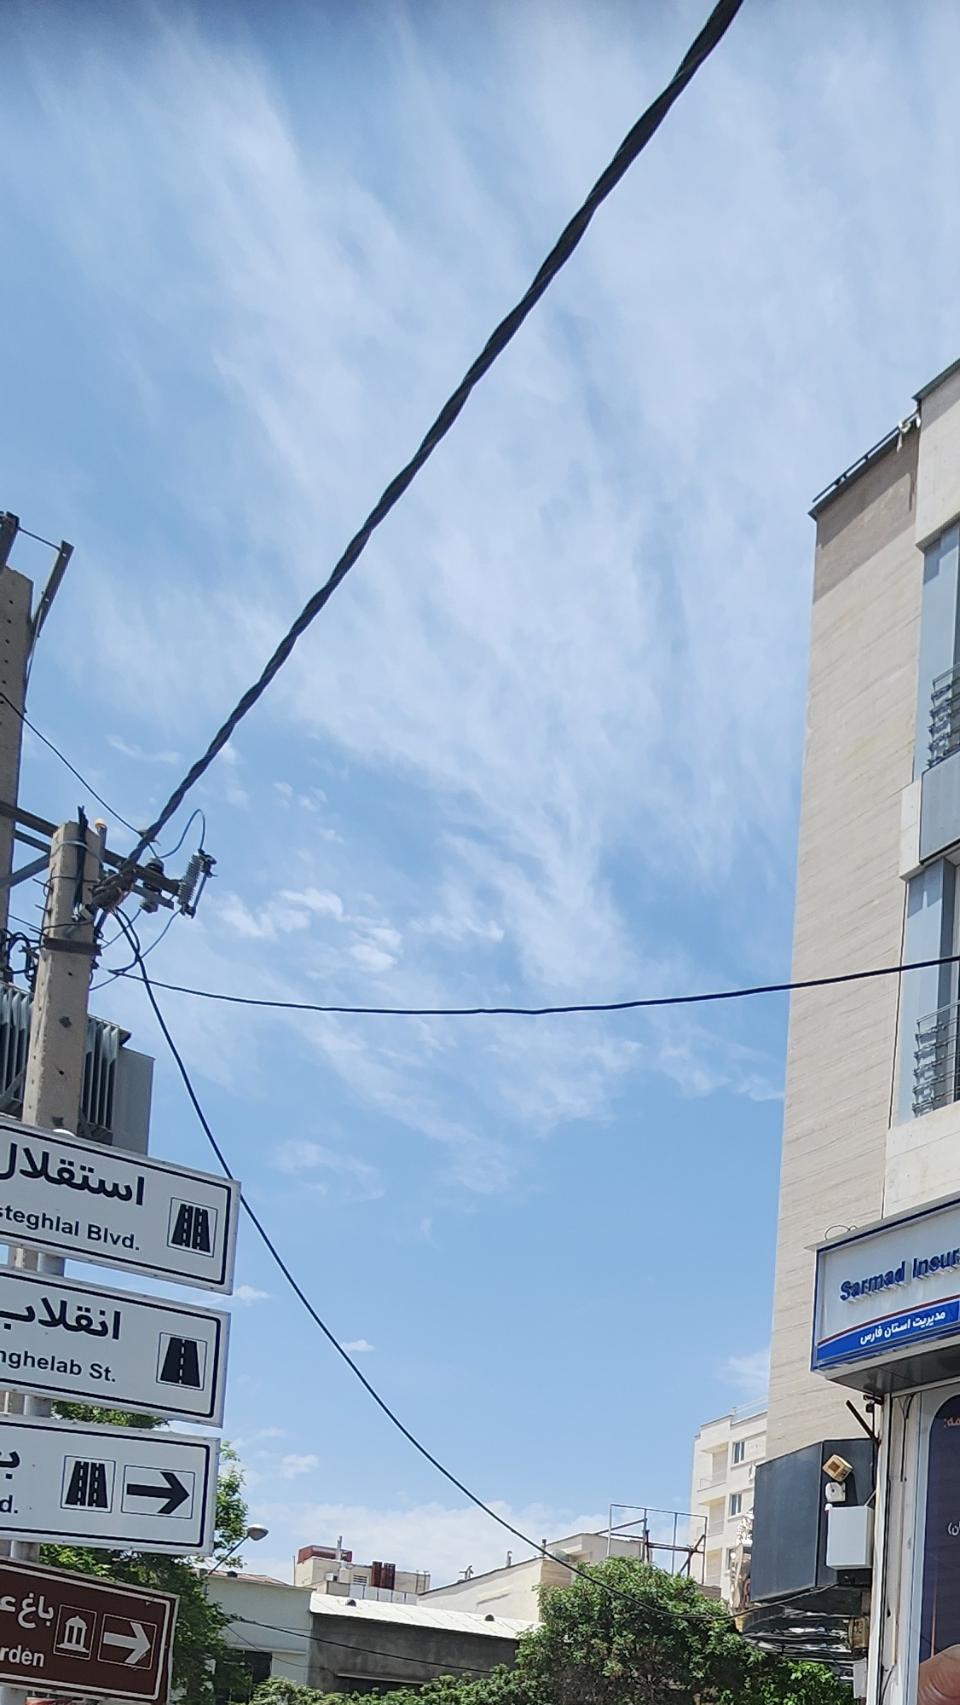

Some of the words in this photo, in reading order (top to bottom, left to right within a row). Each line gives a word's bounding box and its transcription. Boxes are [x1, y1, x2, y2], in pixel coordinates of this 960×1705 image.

[0, 1143, 145, 1206] استقلال
[87, 1224, 140, 1251] Blvd.
[840, 1260, 905, 1302] Sarmad
[0, 1297, 121, 1340] انقلاب
[884, 1317, 911, 1337] استان
[912, 1311, 946, 1329] مدیریت
[859, 1326, 882, 1345] فارس
[89, 1363, 116, 1383] St.
[18, 1593, 54, 1629] باغ
